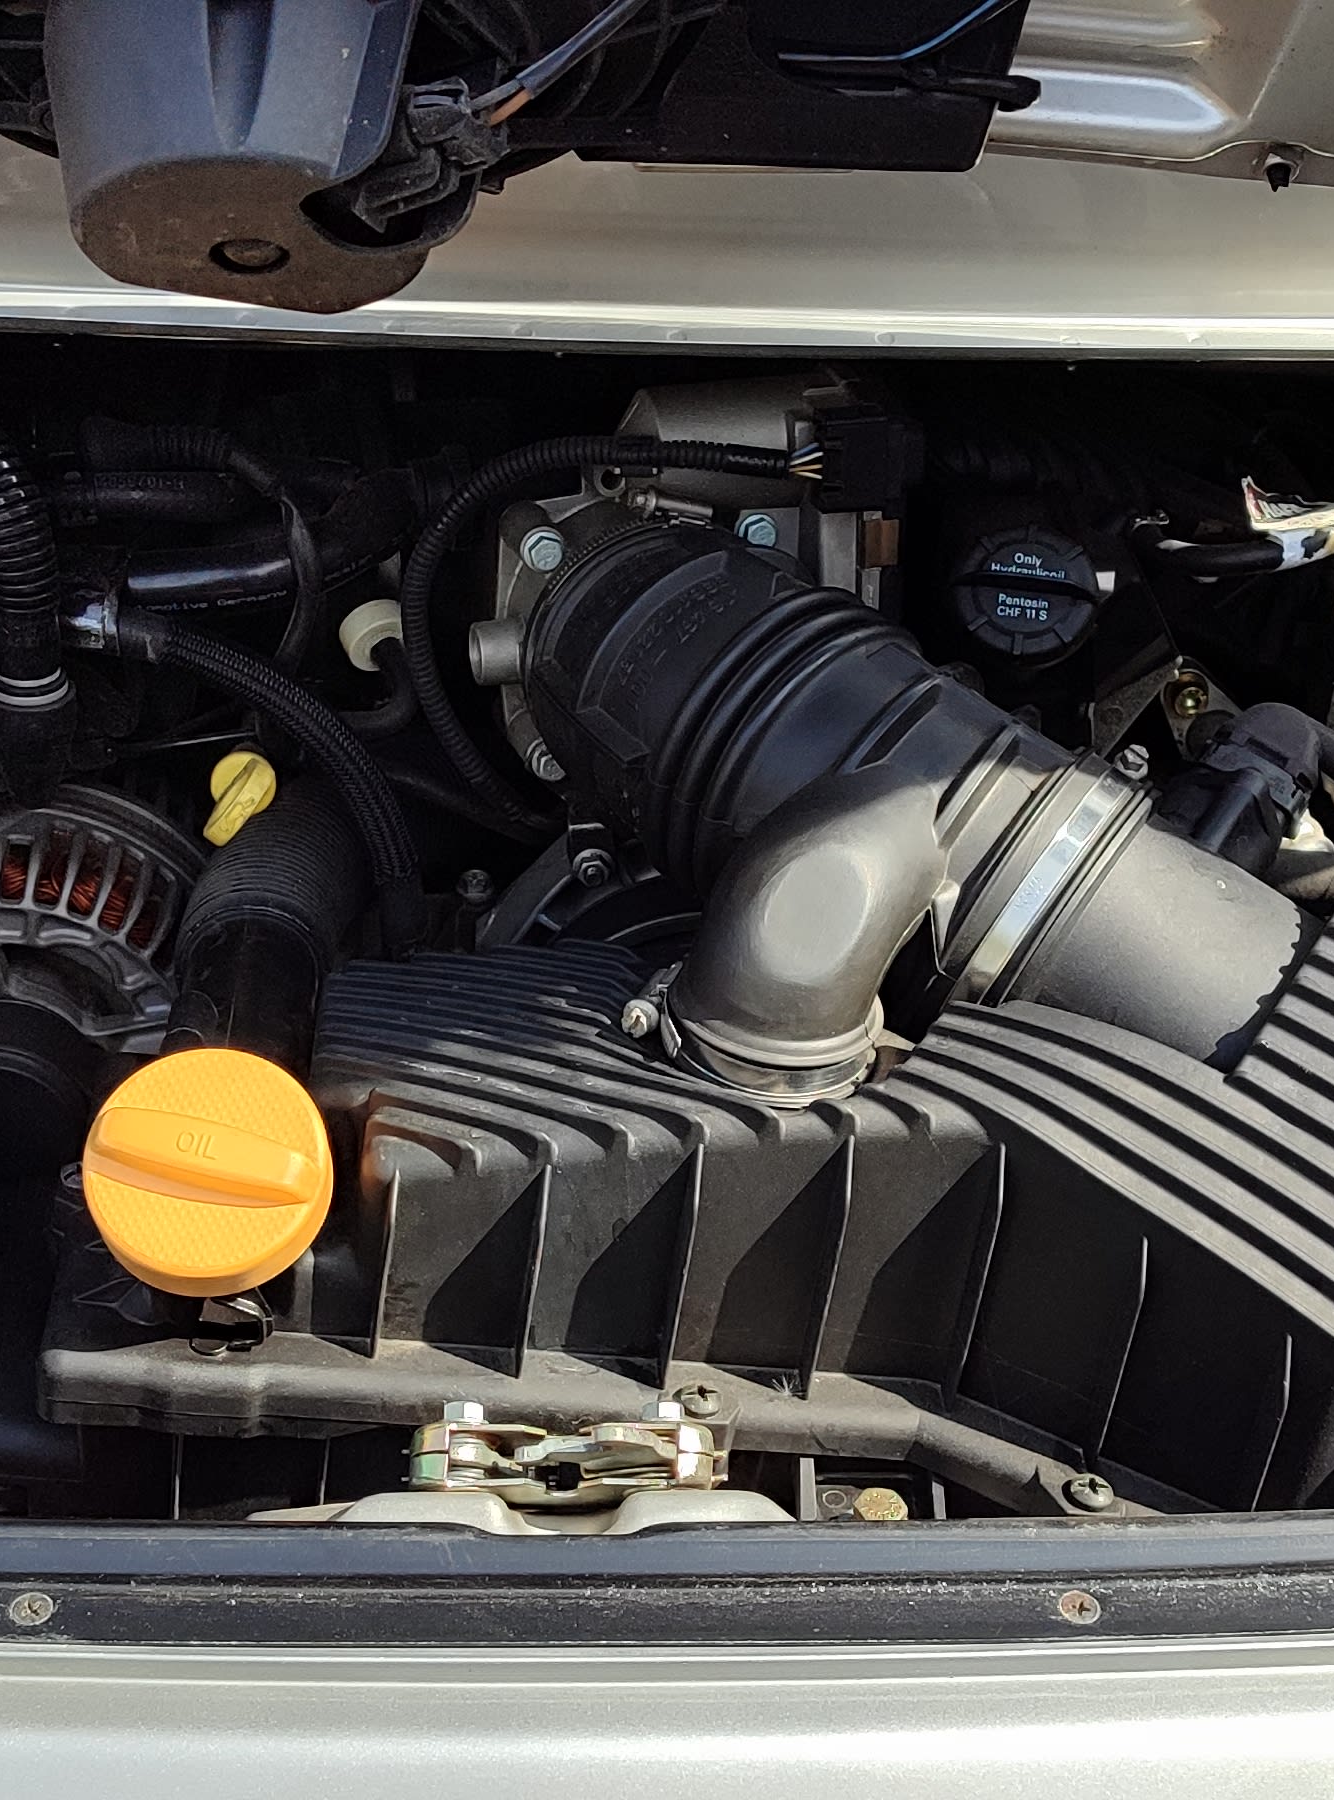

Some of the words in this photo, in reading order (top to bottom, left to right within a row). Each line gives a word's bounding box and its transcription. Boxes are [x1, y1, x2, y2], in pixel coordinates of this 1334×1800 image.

[1014, 552, 1043, 568] Only
[998, 593, 1049, 609] Pentosin
[996, 605, 1022, 617] CHF
[1025, 608, 1036, 619] 11
[1038, 610, 1047, 621] S
[175, 1130, 218, 1161] OIL
